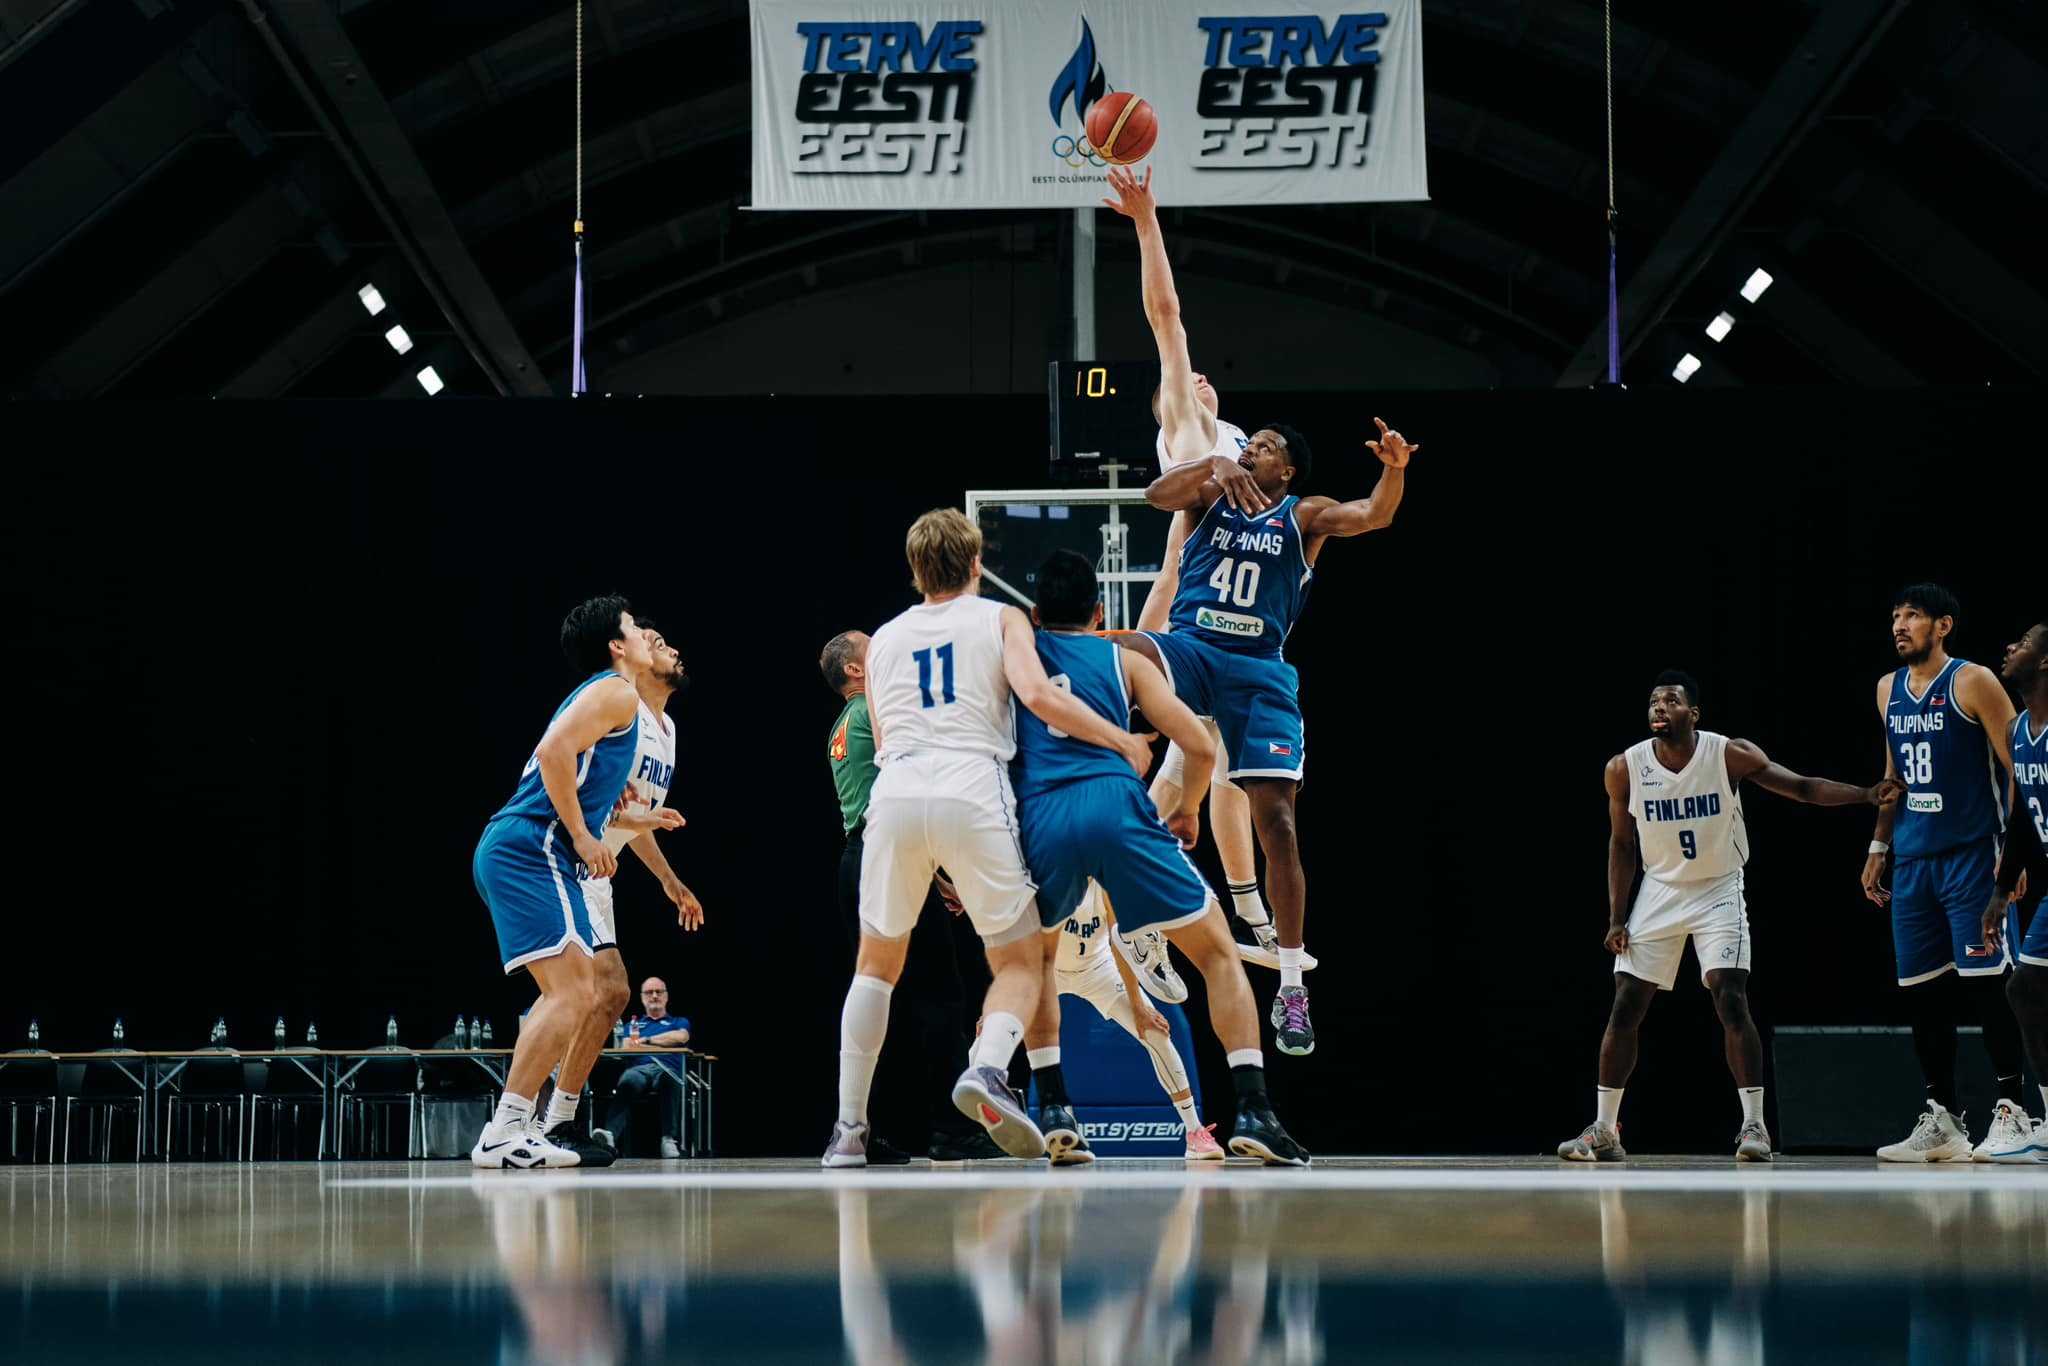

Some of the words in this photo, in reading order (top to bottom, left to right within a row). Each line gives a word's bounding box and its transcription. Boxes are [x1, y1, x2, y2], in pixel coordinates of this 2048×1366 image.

[797, 21, 984, 73] TERVE
[1197, 13, 1388, 68] TERVE
[796, 71, 975, 123] EESTI
[1197, 64, 1376, 119] EESTI
[1032, 176, 1055, 184] EESTI
[1209, 557, 1261, 607] 40
[1215, 616, 1261, 633] Smart
[912, 642, 956, 709] 11
[1900, 741, 1932, 784] 38
[1644, 792, 1720, 822] FINLAND
[1912, 798, 1940, 809] Smart
[1679, 830, 1696, 860] 9
